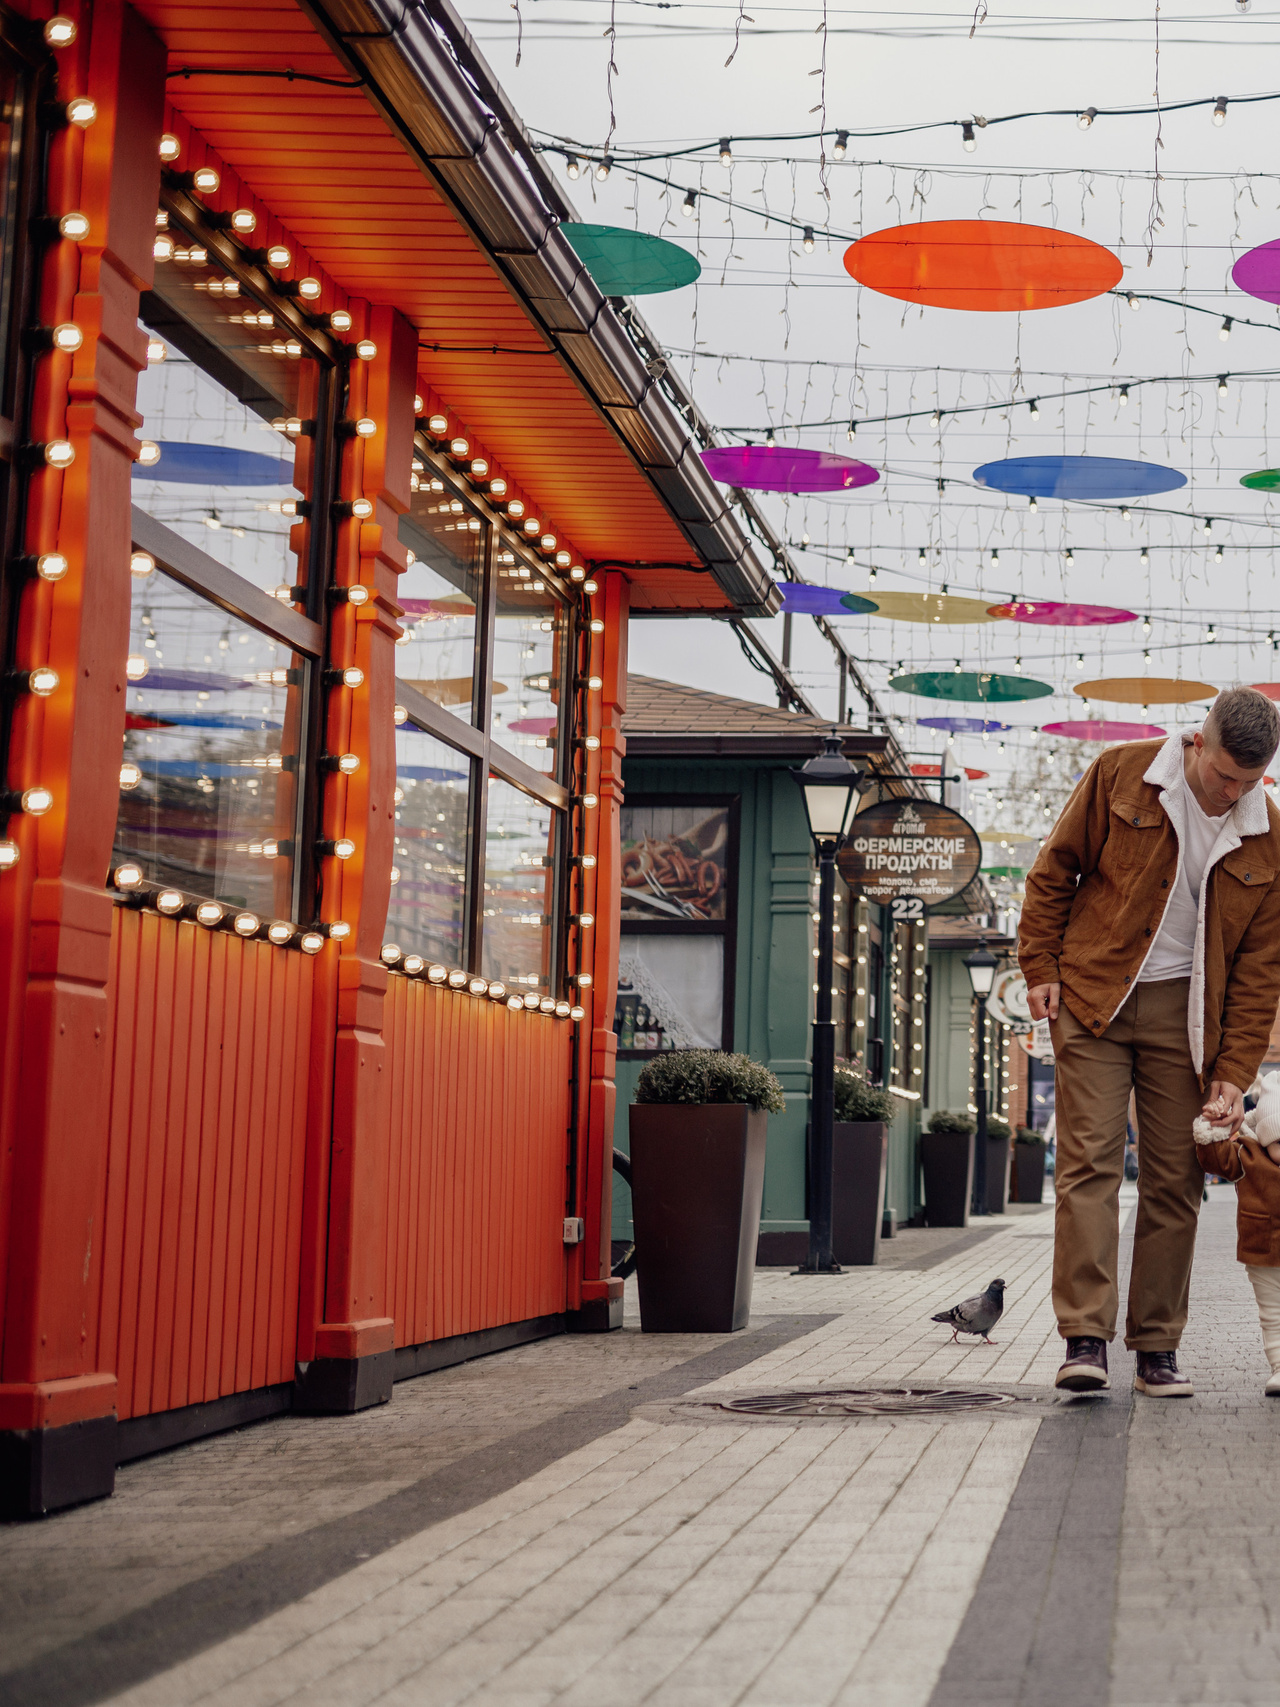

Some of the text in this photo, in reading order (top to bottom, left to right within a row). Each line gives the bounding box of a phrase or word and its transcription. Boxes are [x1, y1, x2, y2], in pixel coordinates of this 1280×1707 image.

[853, 837, 966, 854] ФЕРМЕРСКИЕ
[865, 854, 953, 873] ПРОДУКТЫ
[919, 877, 938, 889] сыр
[899, 886, 954, 896] деликатесы
[891, 898, 924, 919] 22
[1012, 1021, 1032, 1034] 23
